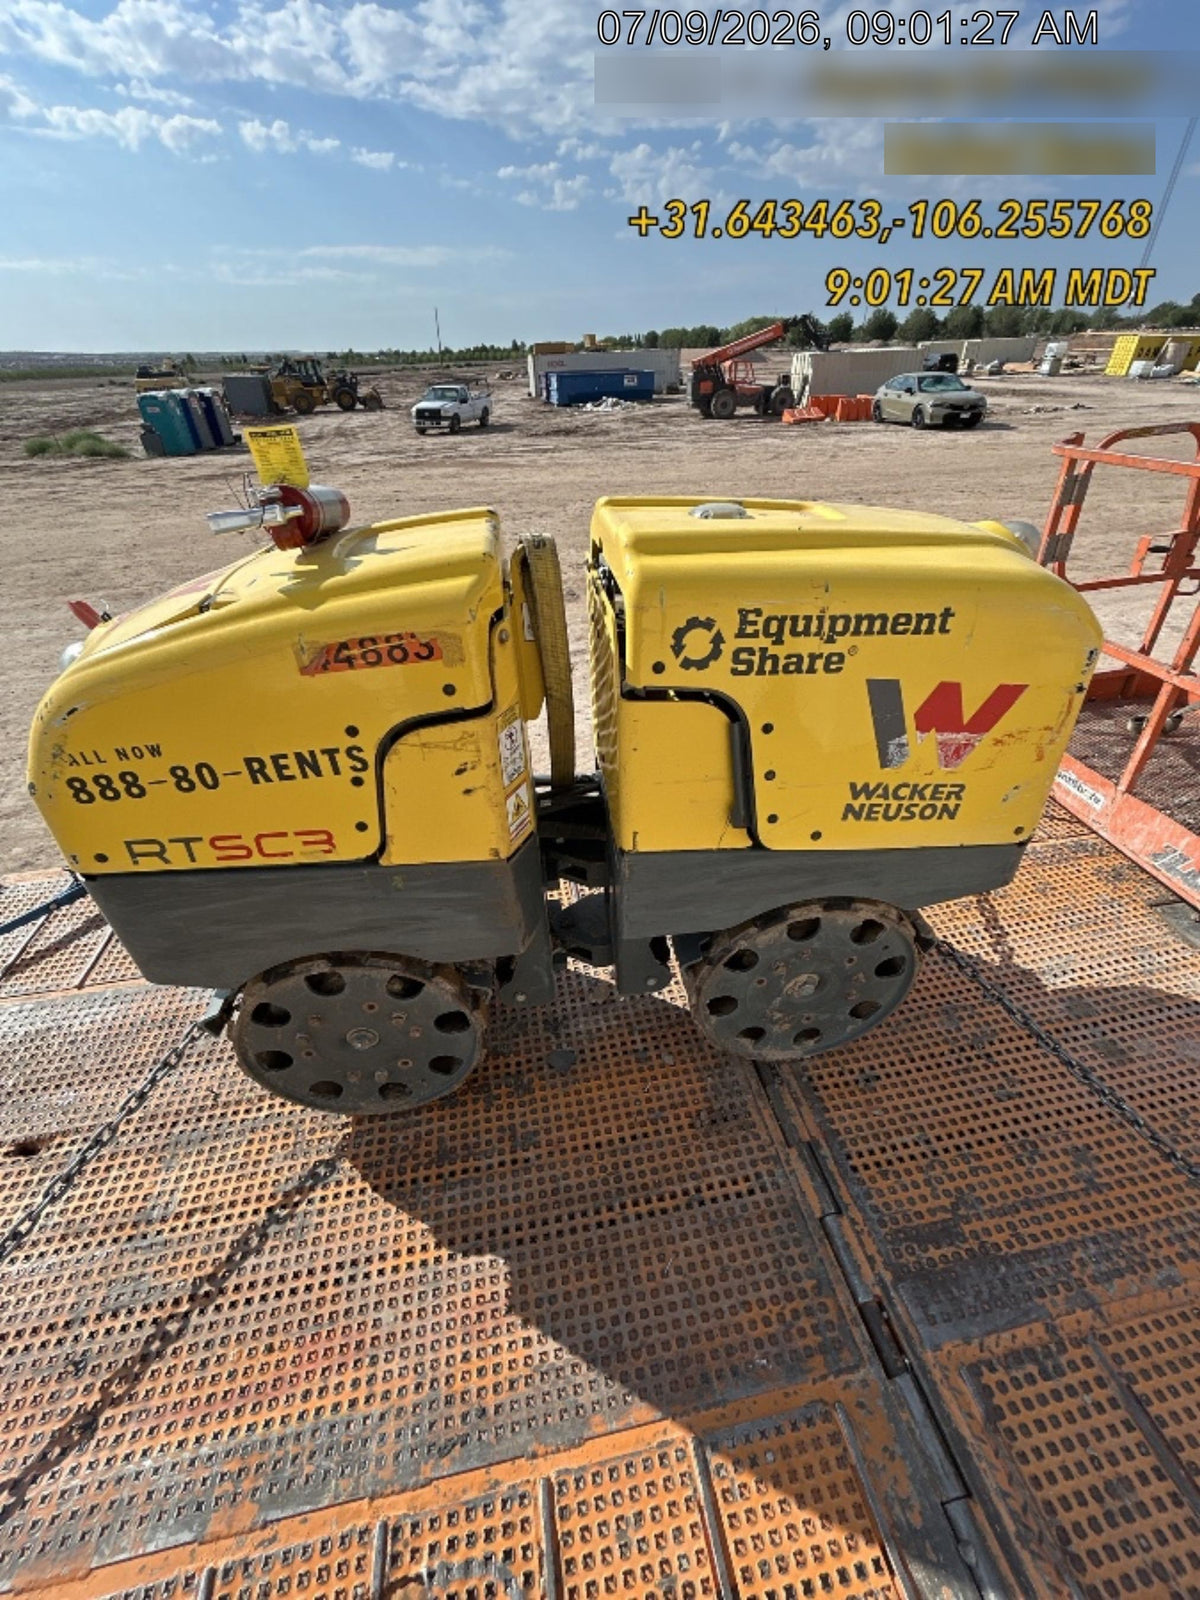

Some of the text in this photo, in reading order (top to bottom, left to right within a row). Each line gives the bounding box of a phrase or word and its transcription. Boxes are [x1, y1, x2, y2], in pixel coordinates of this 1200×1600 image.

[734, 606, 955, 646] Equipment
[63, 743, 163, 767] ALL NOW
[65, 744, 370, 805] 888-80-RENTS
[848, 782, 966, 801] WACKER
[841, 803, 961, 822] NEUSON
